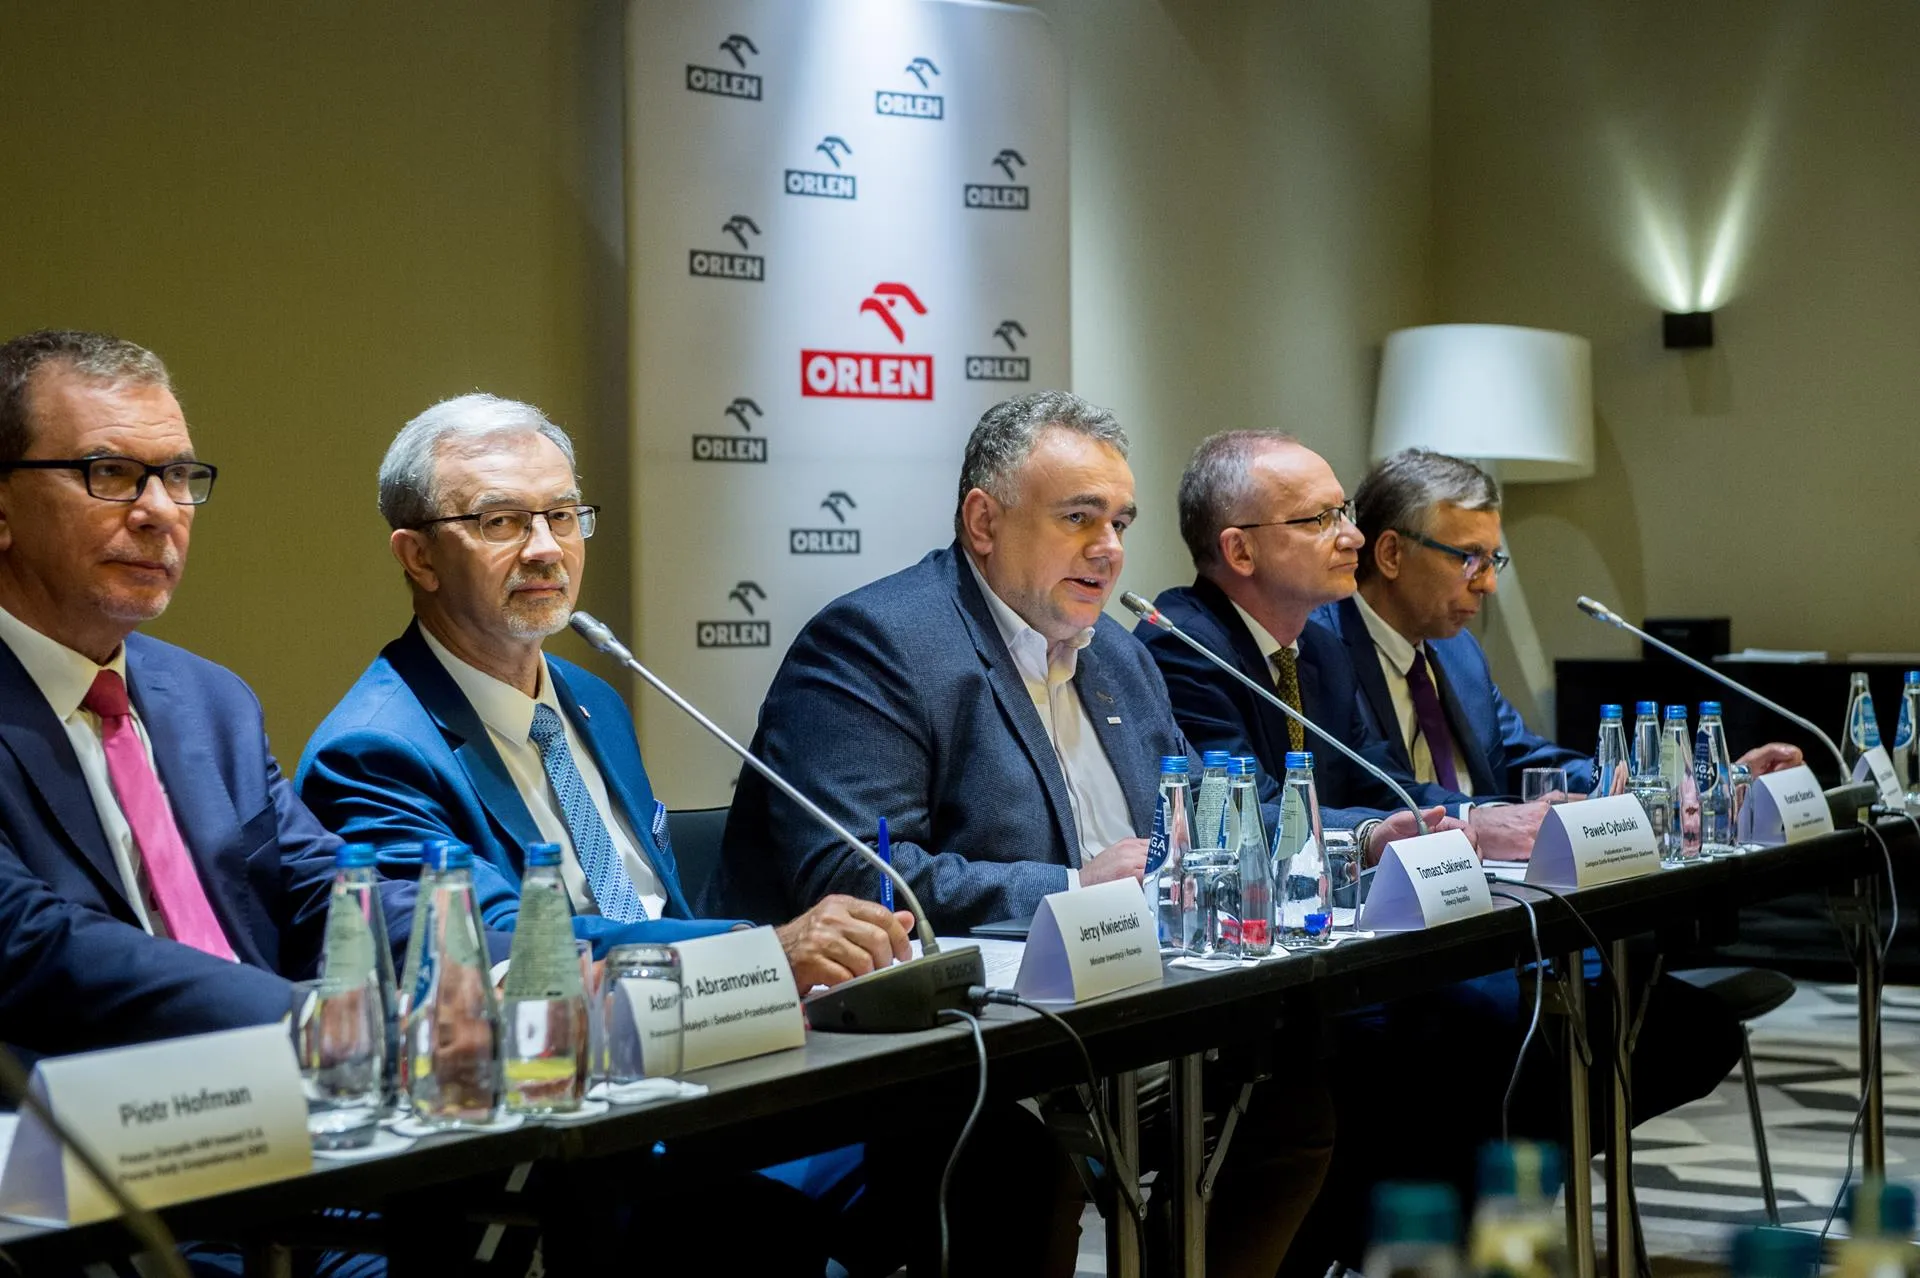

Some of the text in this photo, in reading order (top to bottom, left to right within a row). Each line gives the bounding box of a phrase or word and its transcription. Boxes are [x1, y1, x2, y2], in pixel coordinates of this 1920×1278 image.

[689, 69, 759, 98] ORLEN
[878, 93, 941, 117] ORLEN
[787, 172, 853, 197] ORLEN
[967, 187, 1027, 208] ORLEN
[692, 253, 762, 278] ORLEN
[806, 355, 928, 395] ORLEN
[968, 359, 1028, 379] ORLEN
[695, 438, 764, 460] ORLEN
[792, 531, 859, 552] ORLEN
[699, 623, 768, 645] ORLEN
[1582, 817, 1639, 839] Paweł Cybulski
[1416, 857, 1472, 879] Tomasz Sakiewicz
[1080, 912, 1140, 942] Jerzy Kwieciński
[696, 965, 781, 997] Abramowicz
[118, 1085, 253, 1127] Piotr Hofman
